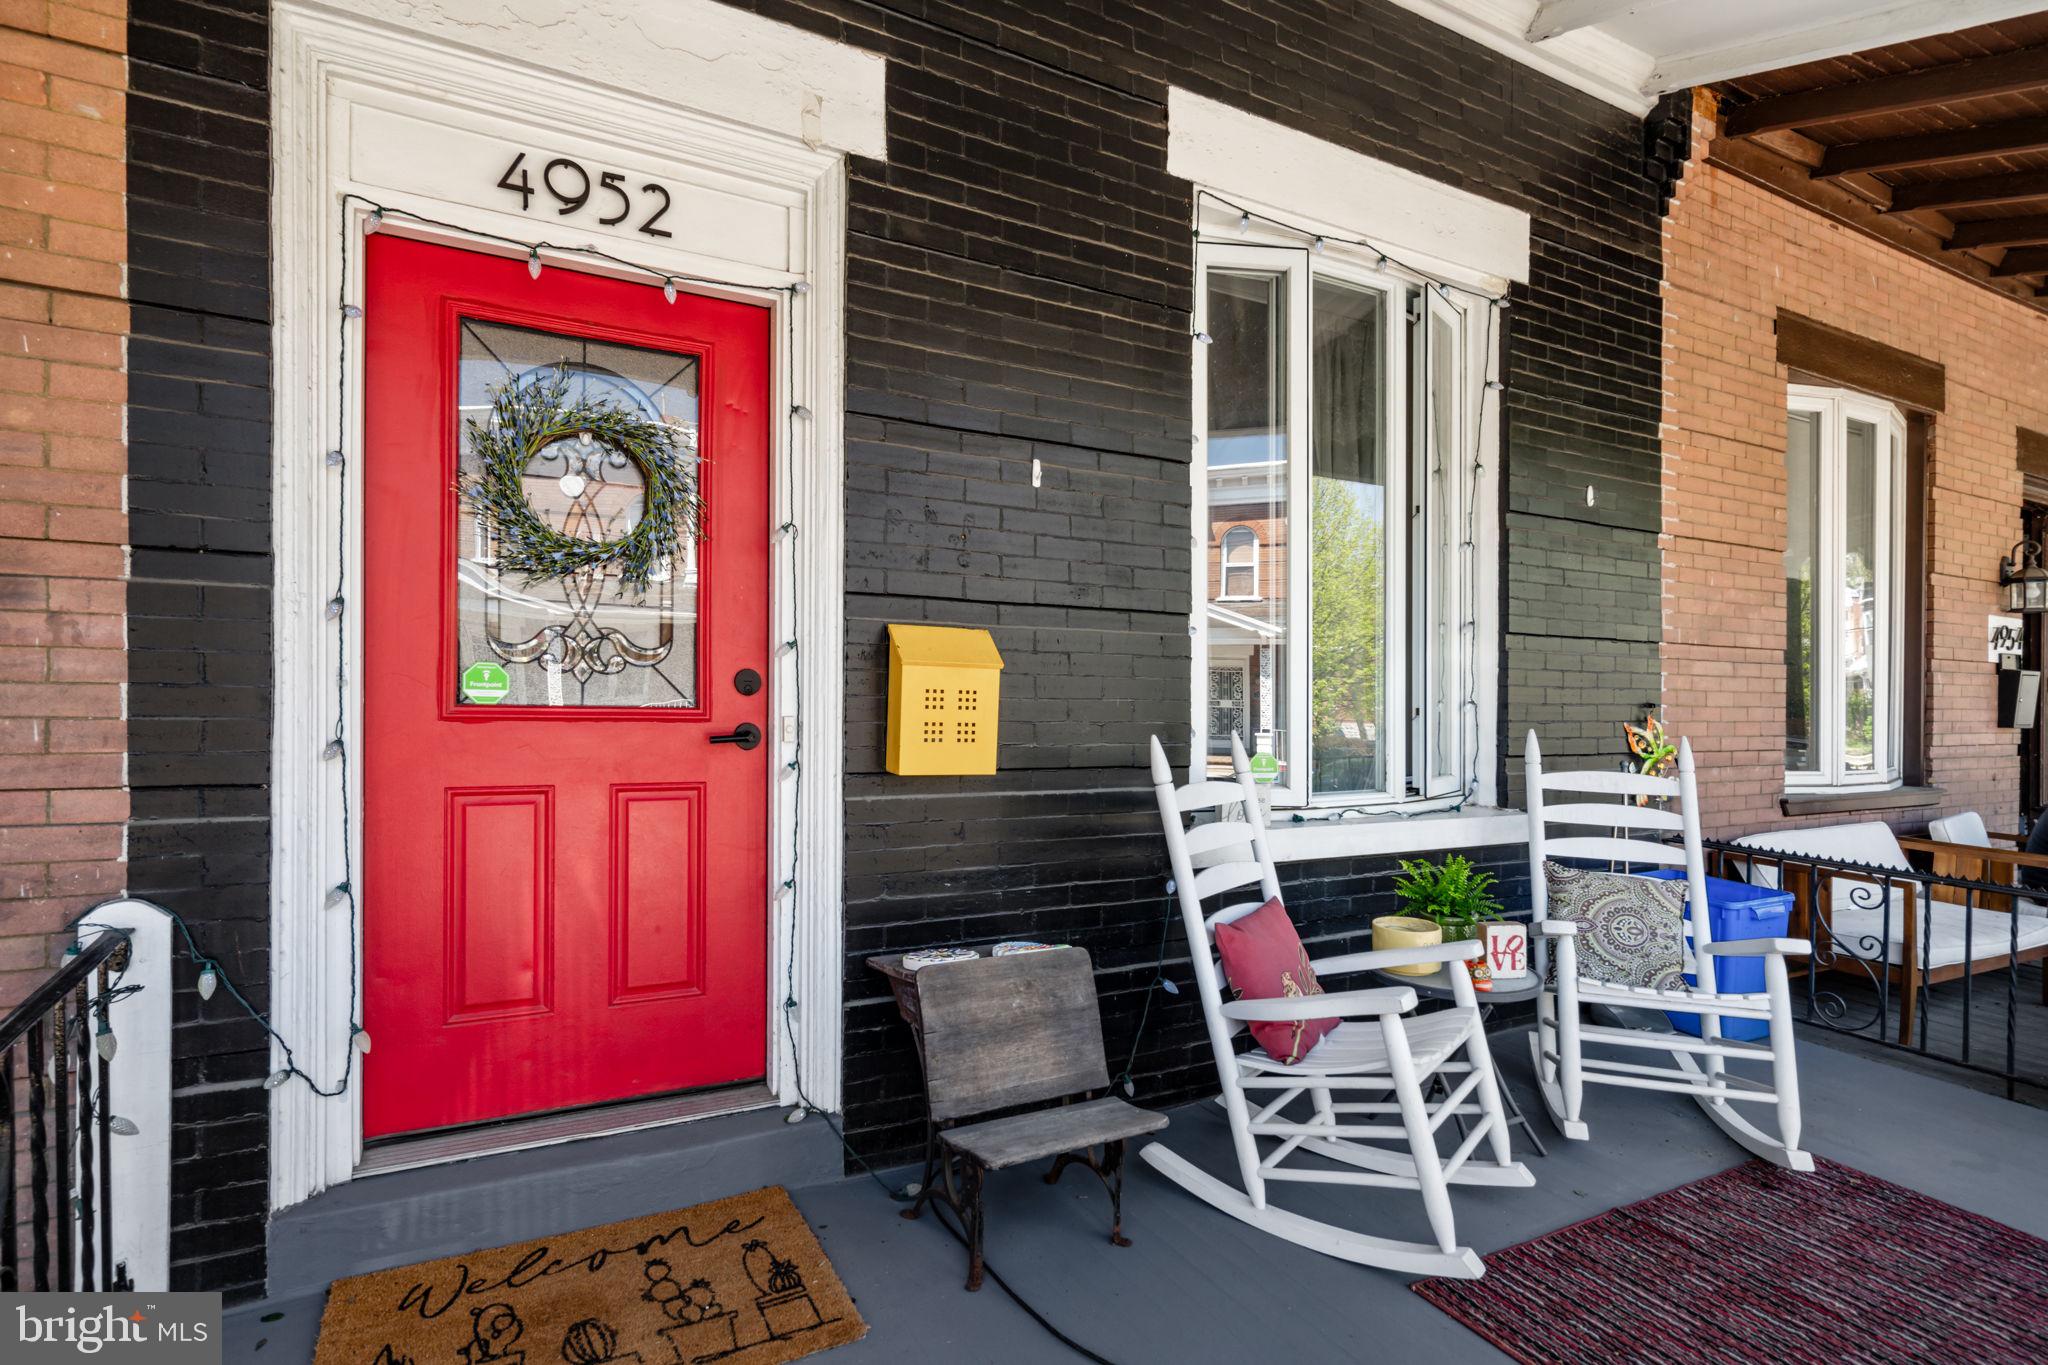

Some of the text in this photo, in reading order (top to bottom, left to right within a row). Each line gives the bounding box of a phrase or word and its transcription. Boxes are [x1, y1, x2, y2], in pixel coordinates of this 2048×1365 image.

[497, 152, 672, 239] 4952
[1490, 934, 1524, 955] LO
[1490, 951, 1526, 971] VE
[397, 1216, 765, 1319] Welcome
